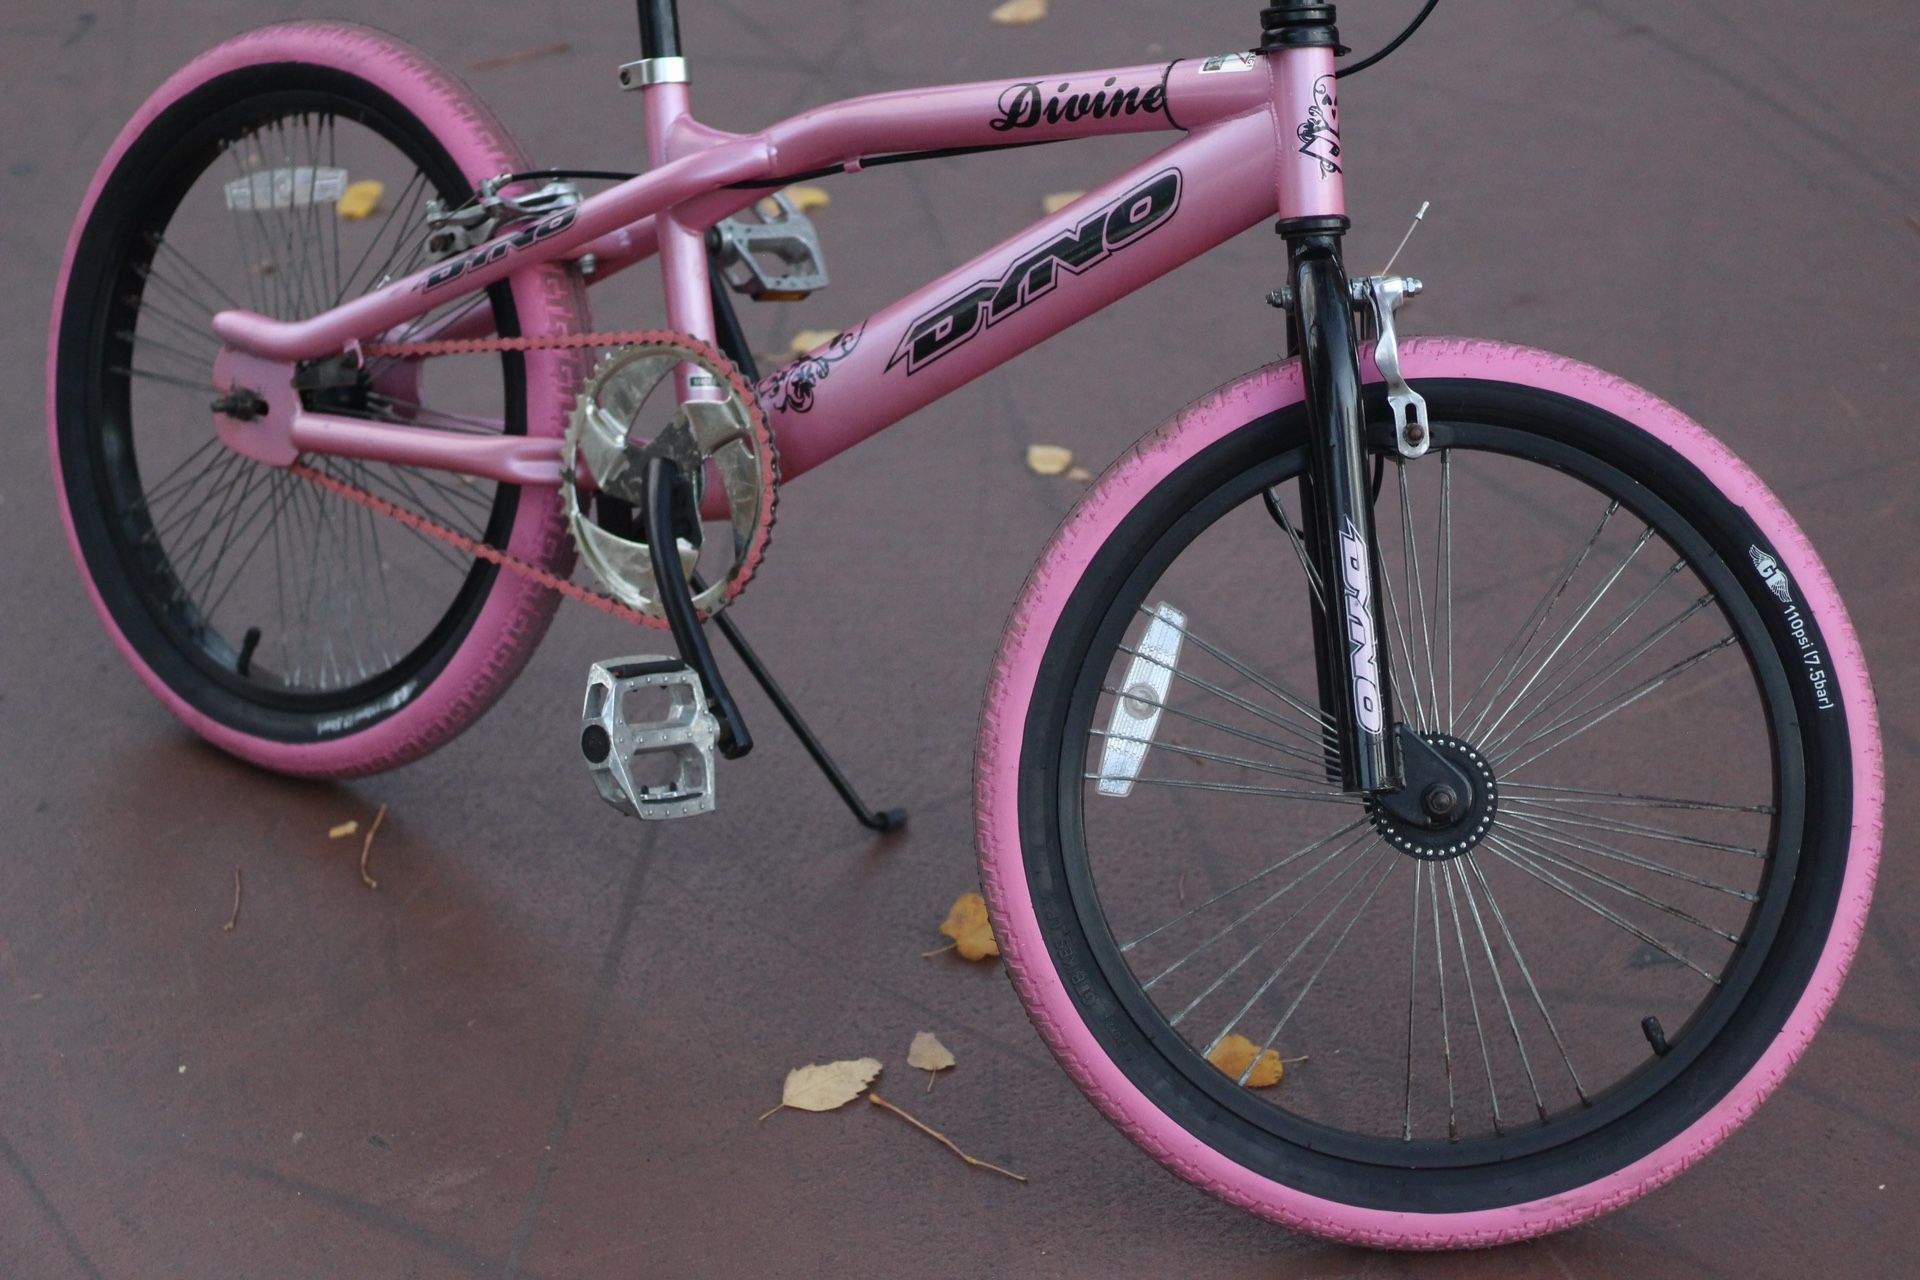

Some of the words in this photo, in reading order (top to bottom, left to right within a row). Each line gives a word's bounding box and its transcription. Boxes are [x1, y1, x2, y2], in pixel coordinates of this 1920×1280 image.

[990, 76, 1166, 131] Divine
[412, 207, 578, 294] DYNO
[884, 167, 1182, 376] DYNO
[1339, 514, 1383, 734] DYNO
[1784, 604, 1814, 650] 110psi
[1803, 650, 1834, 709] (7.5bar)
